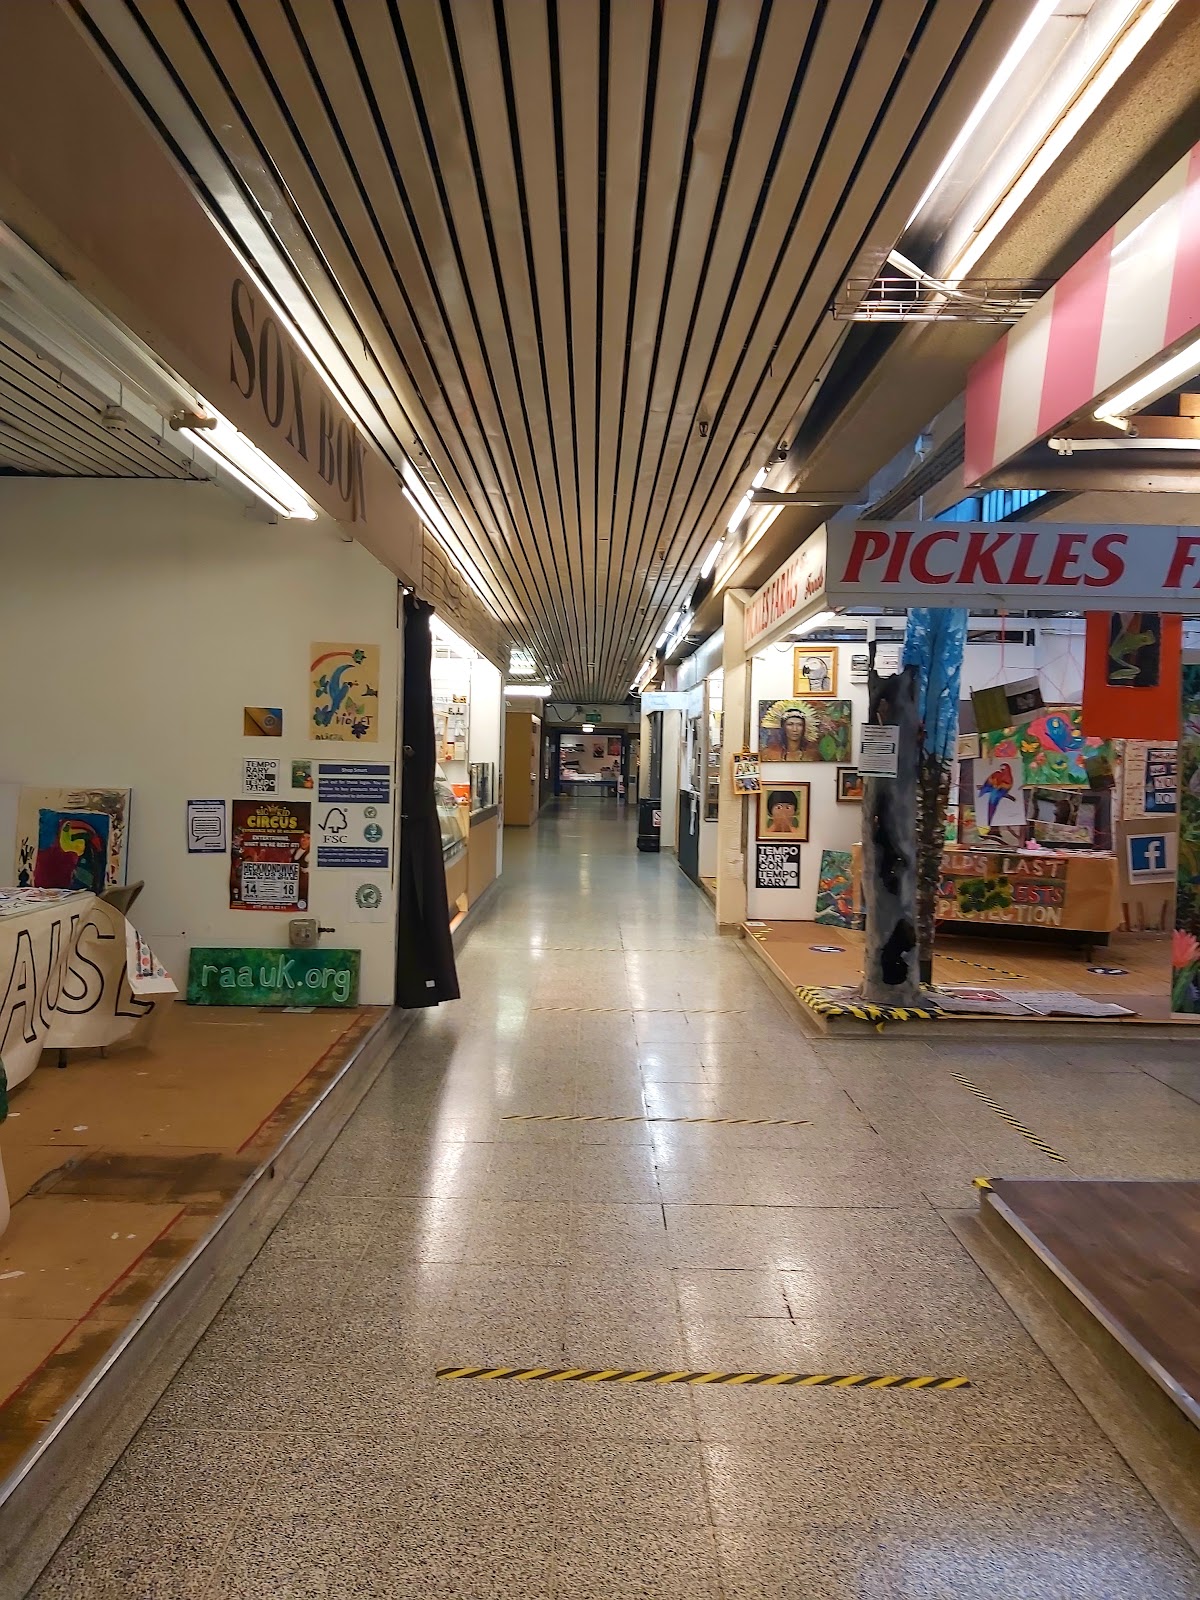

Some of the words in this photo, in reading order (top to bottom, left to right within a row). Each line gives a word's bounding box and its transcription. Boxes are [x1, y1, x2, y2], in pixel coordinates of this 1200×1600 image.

[230, 278, 309, 462] SOX
[840, 530, 1129, 588] PICKLES
[1161, 535, 1200, 589] F
[246, 760, 277, 768] TEMPO
[735, 763, 758, 775] ART
[246, 779, 275, 787] TEMPO
[247, 815, 298, 829] CIRCUS
[323, 835, 348, 844] FSC
[758, 845, 798, 856] TEMPO
[758, 854, 790, 863] RARY
[758, 862, 784, 871] CON
[940, 854, 988, 873] RLD'S
[1002, 858, 1065, 877] LAST
[758, 870, 798, 879] TEMPO
[758, 878, 789, 887] RARY
[244, 883, 257, 894] 14
[282, 884, 295, 895] 18
